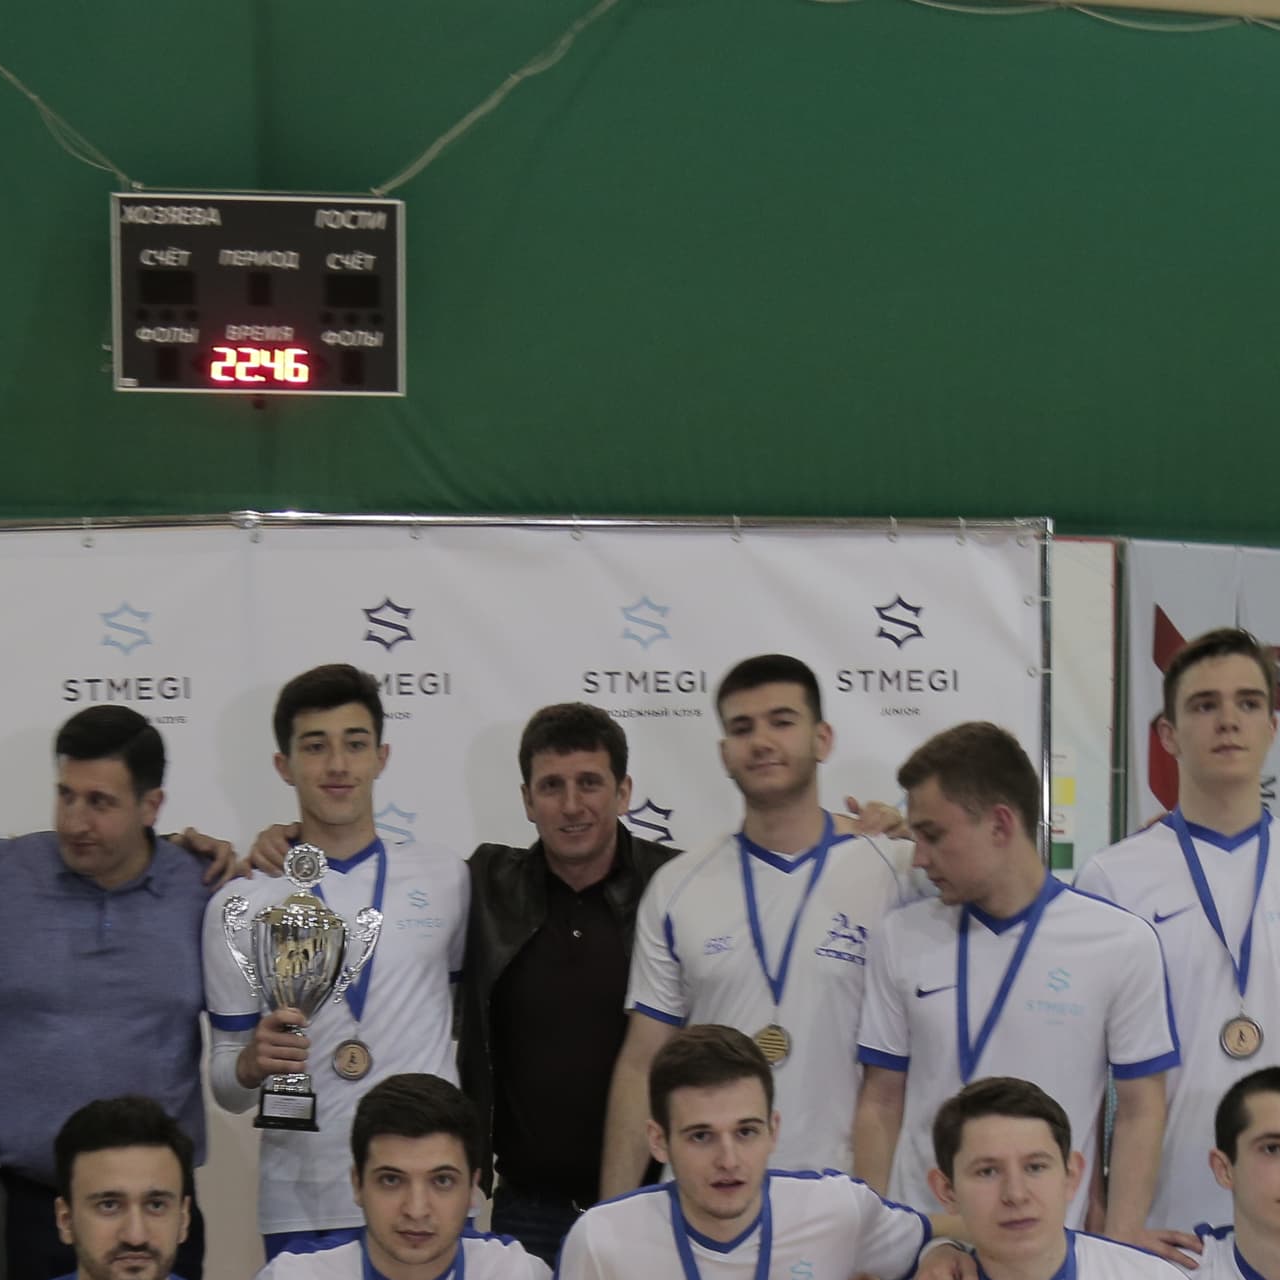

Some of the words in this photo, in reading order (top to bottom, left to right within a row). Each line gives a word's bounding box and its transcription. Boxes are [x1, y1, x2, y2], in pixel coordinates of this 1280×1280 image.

[121, 205, 222, 226] ХОЗЯЕВА
[315, 208, 387, 229] ГОСТИ
[218, 249, 300, 269] ПЕРИОД
[135, 326, 200, 343] ФОЛЫ
[225, 325, 295, 341] ВРЕМЯ
[321, 329, 384, 347] ФОЛЫ
[62, 676, 192, 701] STMEGI
[583, 669, 708, 693] STMEGI
[837, 669, 959, 692] STMEGI
